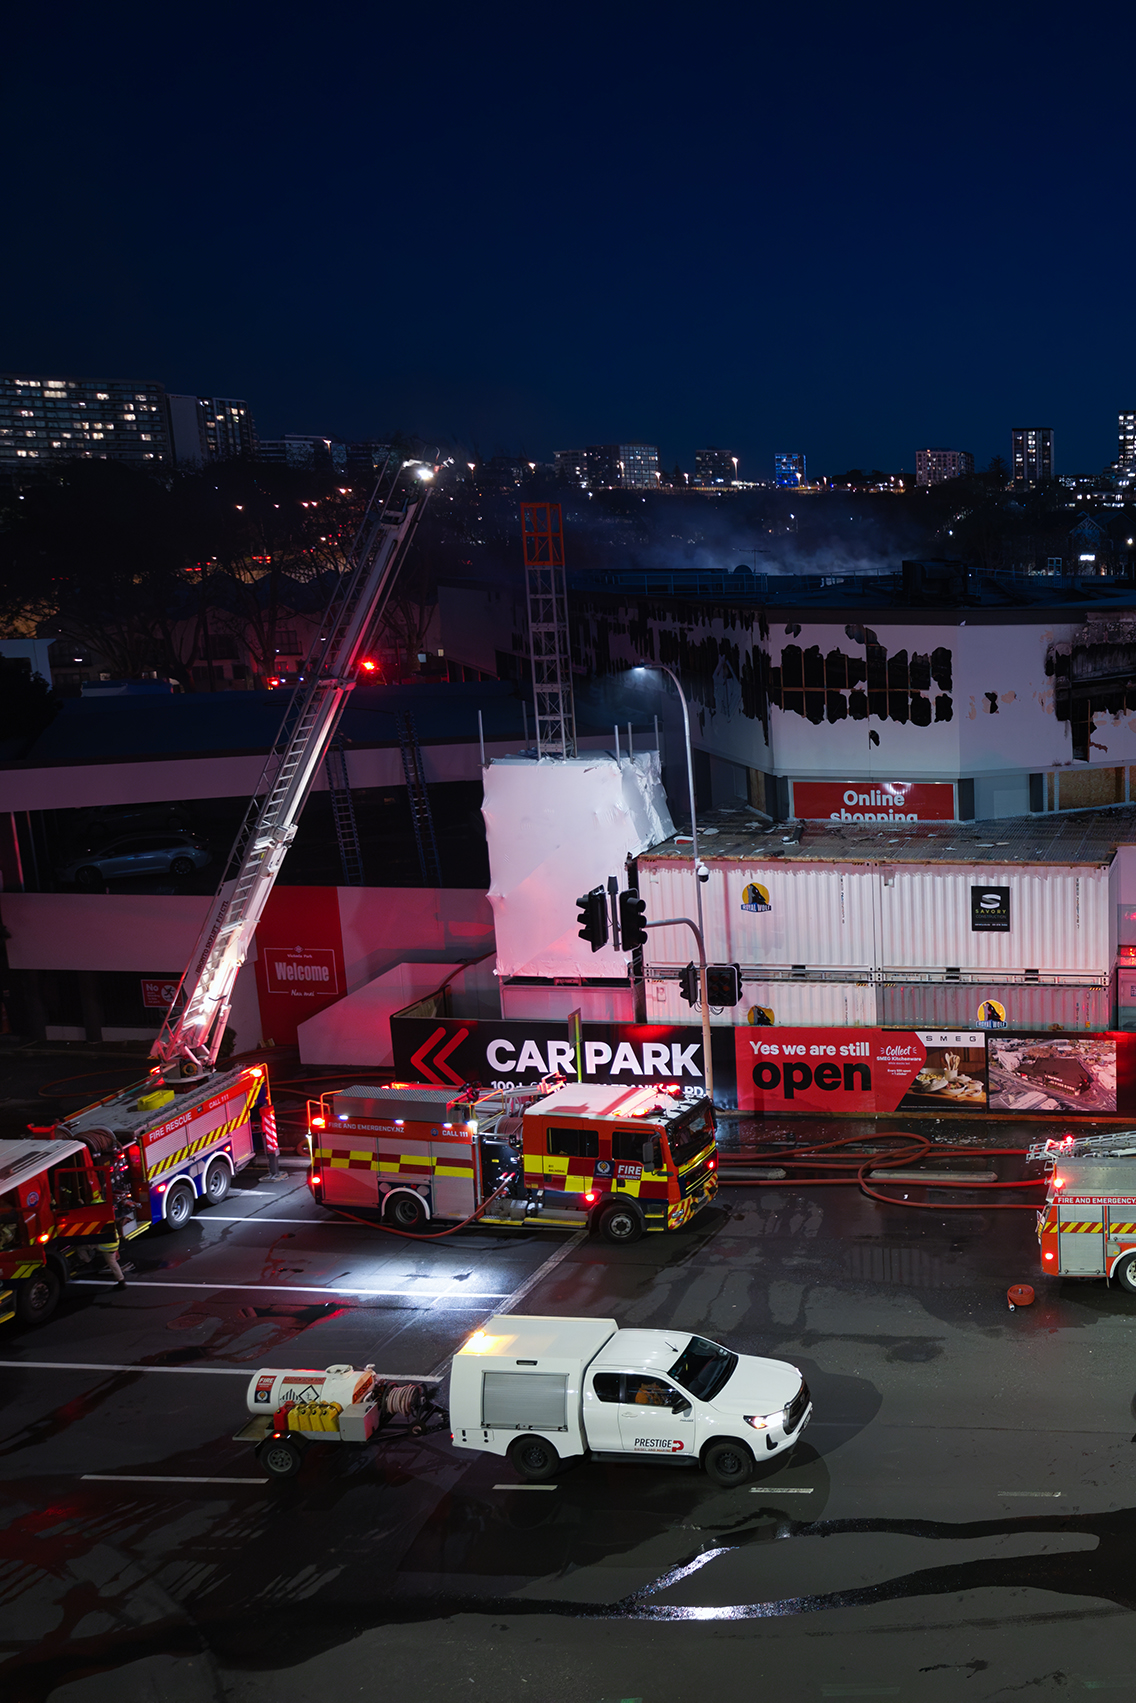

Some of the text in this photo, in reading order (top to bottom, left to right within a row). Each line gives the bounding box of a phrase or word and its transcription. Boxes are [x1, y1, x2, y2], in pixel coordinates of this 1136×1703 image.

[843, 789, 905, 807] Online
[274, 961, 330, 982] Welcome
[146, 983, 159, 991] No
[925, 1035, 977, 1043] SMEG
[749, 1041, 870, 1057] Yes we are still
[885, 1045, 912, 1056] Collect
[486, 1038, 703, 1077] CAR PARK
[752, 1061, 872, 1100] open
[208, 1094, 229, 1109] CALL 111
[149, 1112, 192, 1142] FIRE RESCUE
[357, 1124, 405, 1133] EMERGENCY.NZ
[442, 1129, 459, 1137] CALL
[617, 1165, 643, 1175] FIRE
[634, 1437, 672, 1448] PRESTIGE
